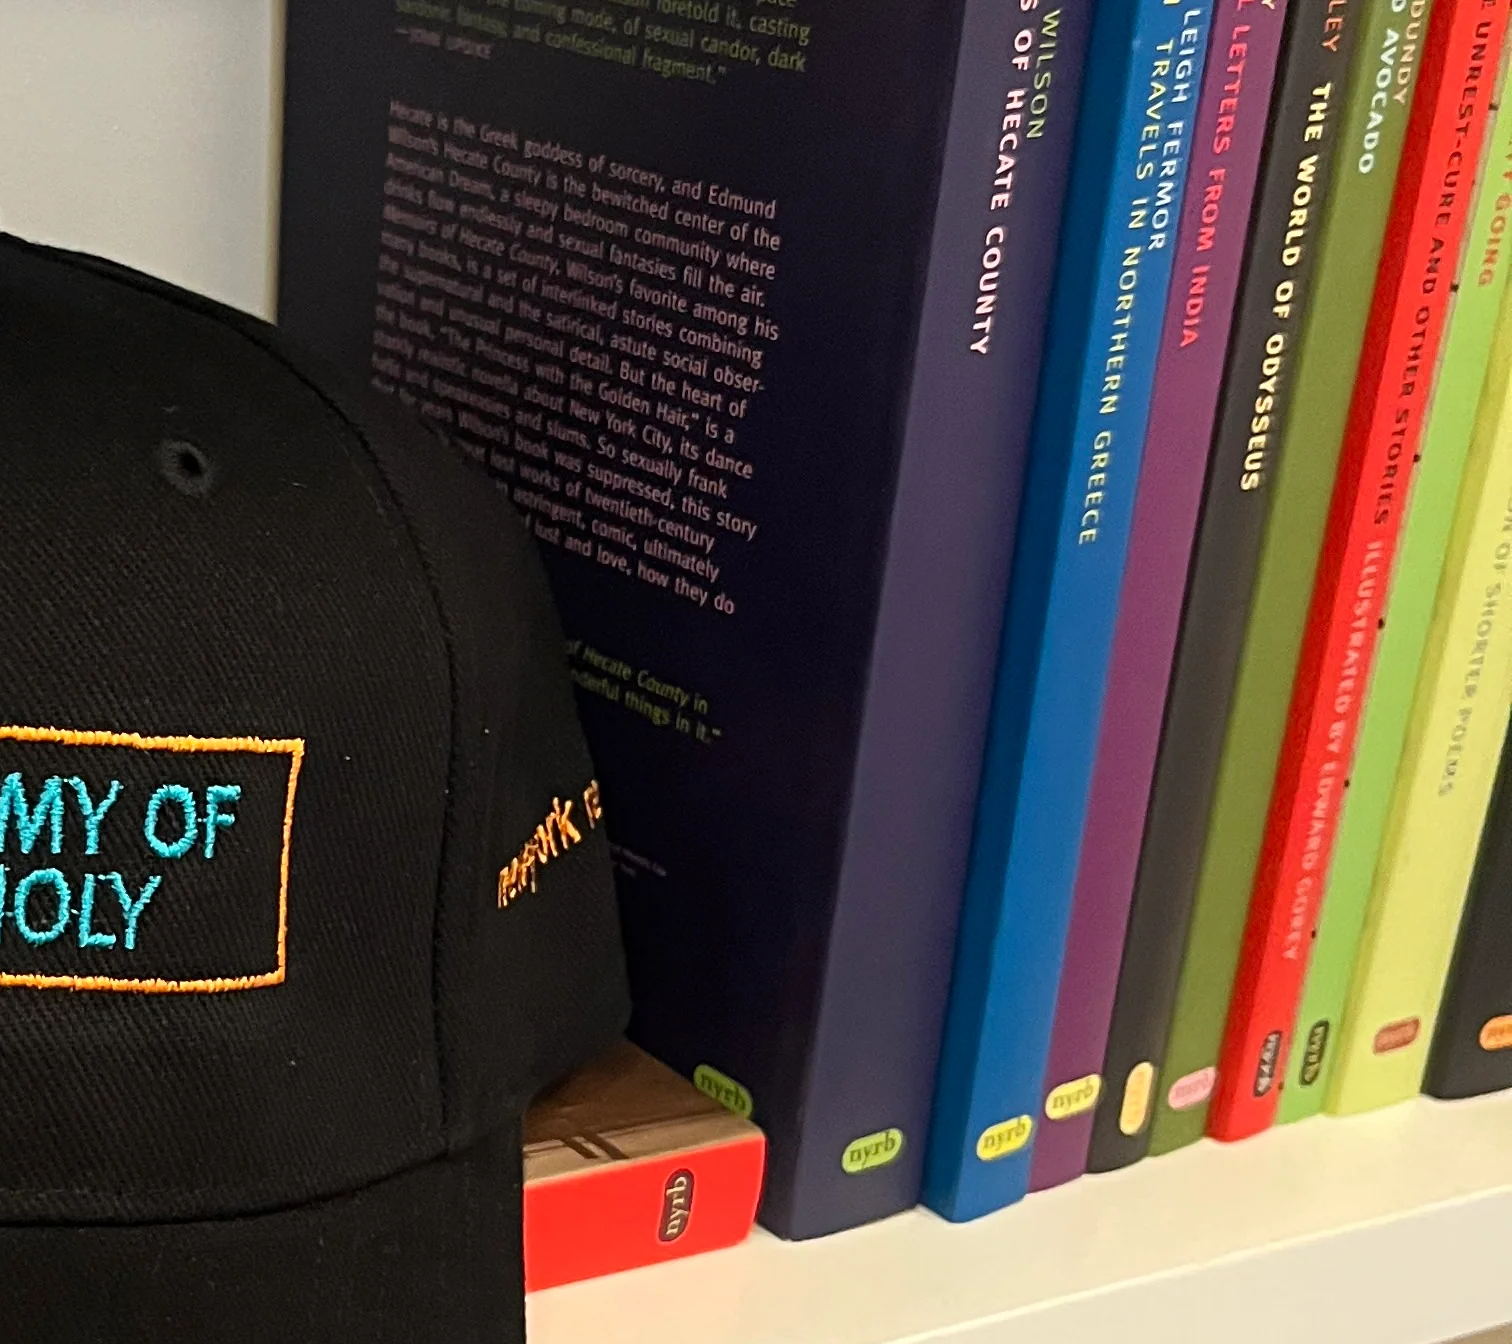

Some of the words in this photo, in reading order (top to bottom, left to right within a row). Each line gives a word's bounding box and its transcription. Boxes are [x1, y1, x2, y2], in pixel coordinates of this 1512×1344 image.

[1011, 29, 1032, 70] OF
[1025, 9, 1060, 139] WILSON
[1173, 9, 1200, 103] LEIGH
[1213, 24, 1249, 154] LETTERS
[1391, 0, 1425, 105] DUNDY
[1135, 40, 1173, 179] TRAVELS
[1302, 81, 1330, 140] THE
[1357, 27, 1399, 173] AVOCADO
[1436, 18, 1490, 226] UNREST-CURE
[989, 89, 1025, 210] HECATE
[1147, 120, 1183, 250] FERMOR
[1128, 197, 1147, 228] IN
[1197, 168, 1224, 251] FROM
[1281, 154, 1317, 265] WORLD
[1476, 191, 1512, 286] GOING
[969, 226, 1006, 353] COUNTY
[1179, 264, 1209, 347] INDIA
[1272, 279, 1292, 318] OF
[1422, 236, 1442, 295] AND
[1099, 247, 1138, 414] NORTHERN
[1401, 305, 1429, 396] OTHER
[1240, 333, 1282, 491] ODYSSEUS
[1078, 430, 1111, 544] GREECE
[1373, 407, 1408, 524] STORIES
[143, 782, 242, 860] OF
[700, 1071, 748, 1113] nyrb
[983, 1119, 1026, 1151] nyrb
[1051, 1080, 1094, 1112] nyrb
[848, 1132, 896, 1166] nyrb
[663, 1173, 686, 1236] nyrb
